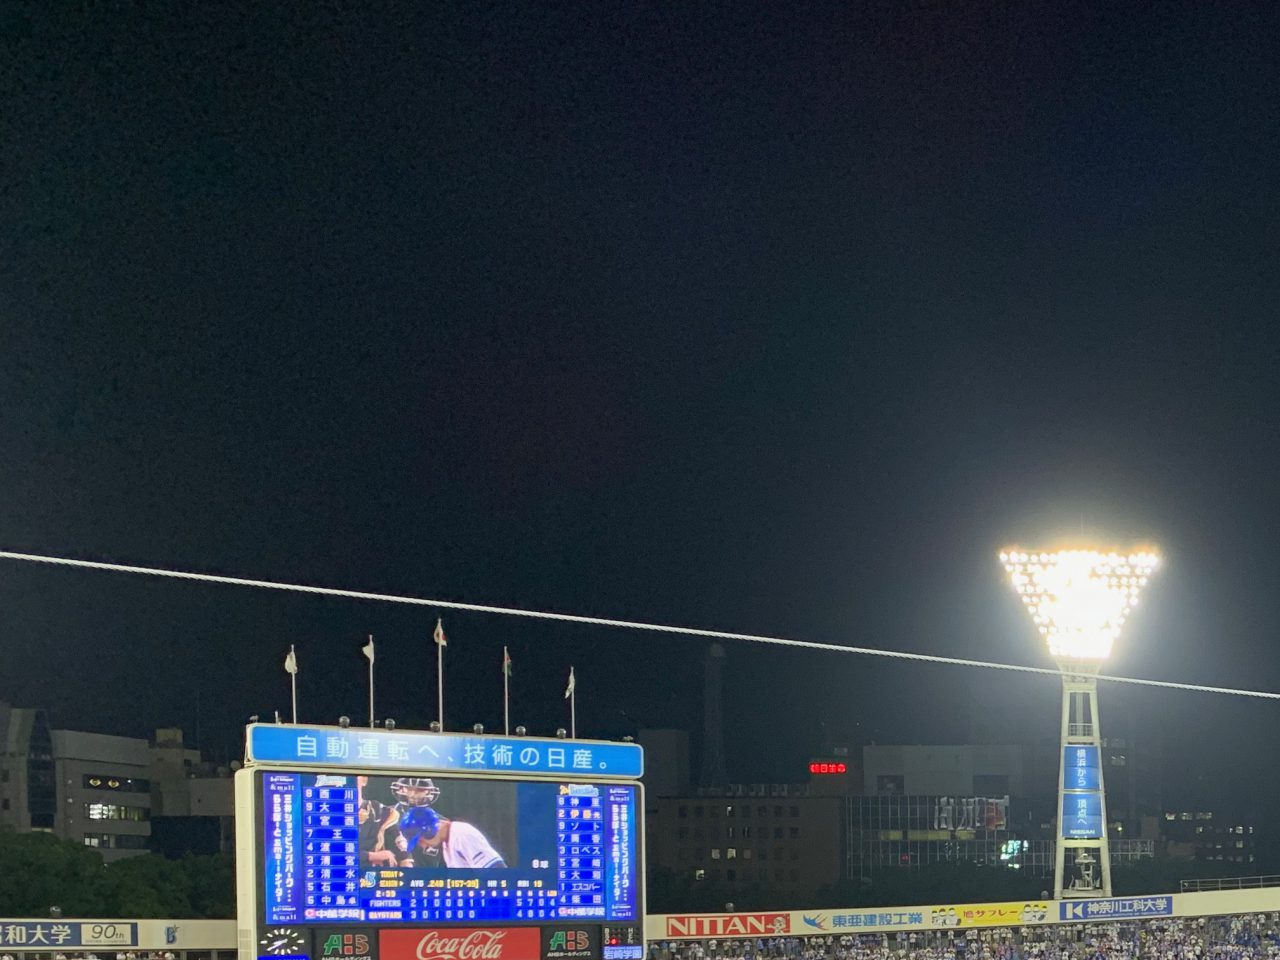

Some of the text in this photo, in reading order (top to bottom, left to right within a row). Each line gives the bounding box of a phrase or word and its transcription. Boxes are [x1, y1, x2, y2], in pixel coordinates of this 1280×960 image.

[297, 735, 607, 769] 自動運転へ、技術の日産。
[1076, 749, 1087, 787] 横浜から
[305, 789, 312, 797] 8
[306, 803, 312, 811] 9
[1077, 800, 1087, 825] 頂点へ
[307, 816, 311, 824] 1
[306, 829, 342, 839] 7 王
[307, 842, 314, 851] 4
[571, 846, 600, 855] ロペス
[307, 856, 314, 865] 3
[307, 869, 314, 878] 2
[308, 883, 314, 891] 5
[308, 896, 314, 905] 6
[370, 899, 555, 908] FIGHTERS 2 1 0 0 0 1 1 5 7 0 4
[1087, 898, 1167, 915] 神奈川工科大学
[411, 910, 417, 918] 3
[423, 910, 428, 918] 0
[435, 910, 439, 918] 1
[446, 910, 451, 918] 0
[458, 910, 463, 918] 0
[469, 910, 475, 918] 0
[517, 910, 523, 918] 4
[538, 910, 544, 918] 0
[549, 910, 556, 918] 4
[832, 911, 923, 928] 東亜建設工業
[668, 916, 766, 936] NITTAN
[0, 924, 72, 945] 和大学
[416, 930, 508, 960] Coca-Cola
